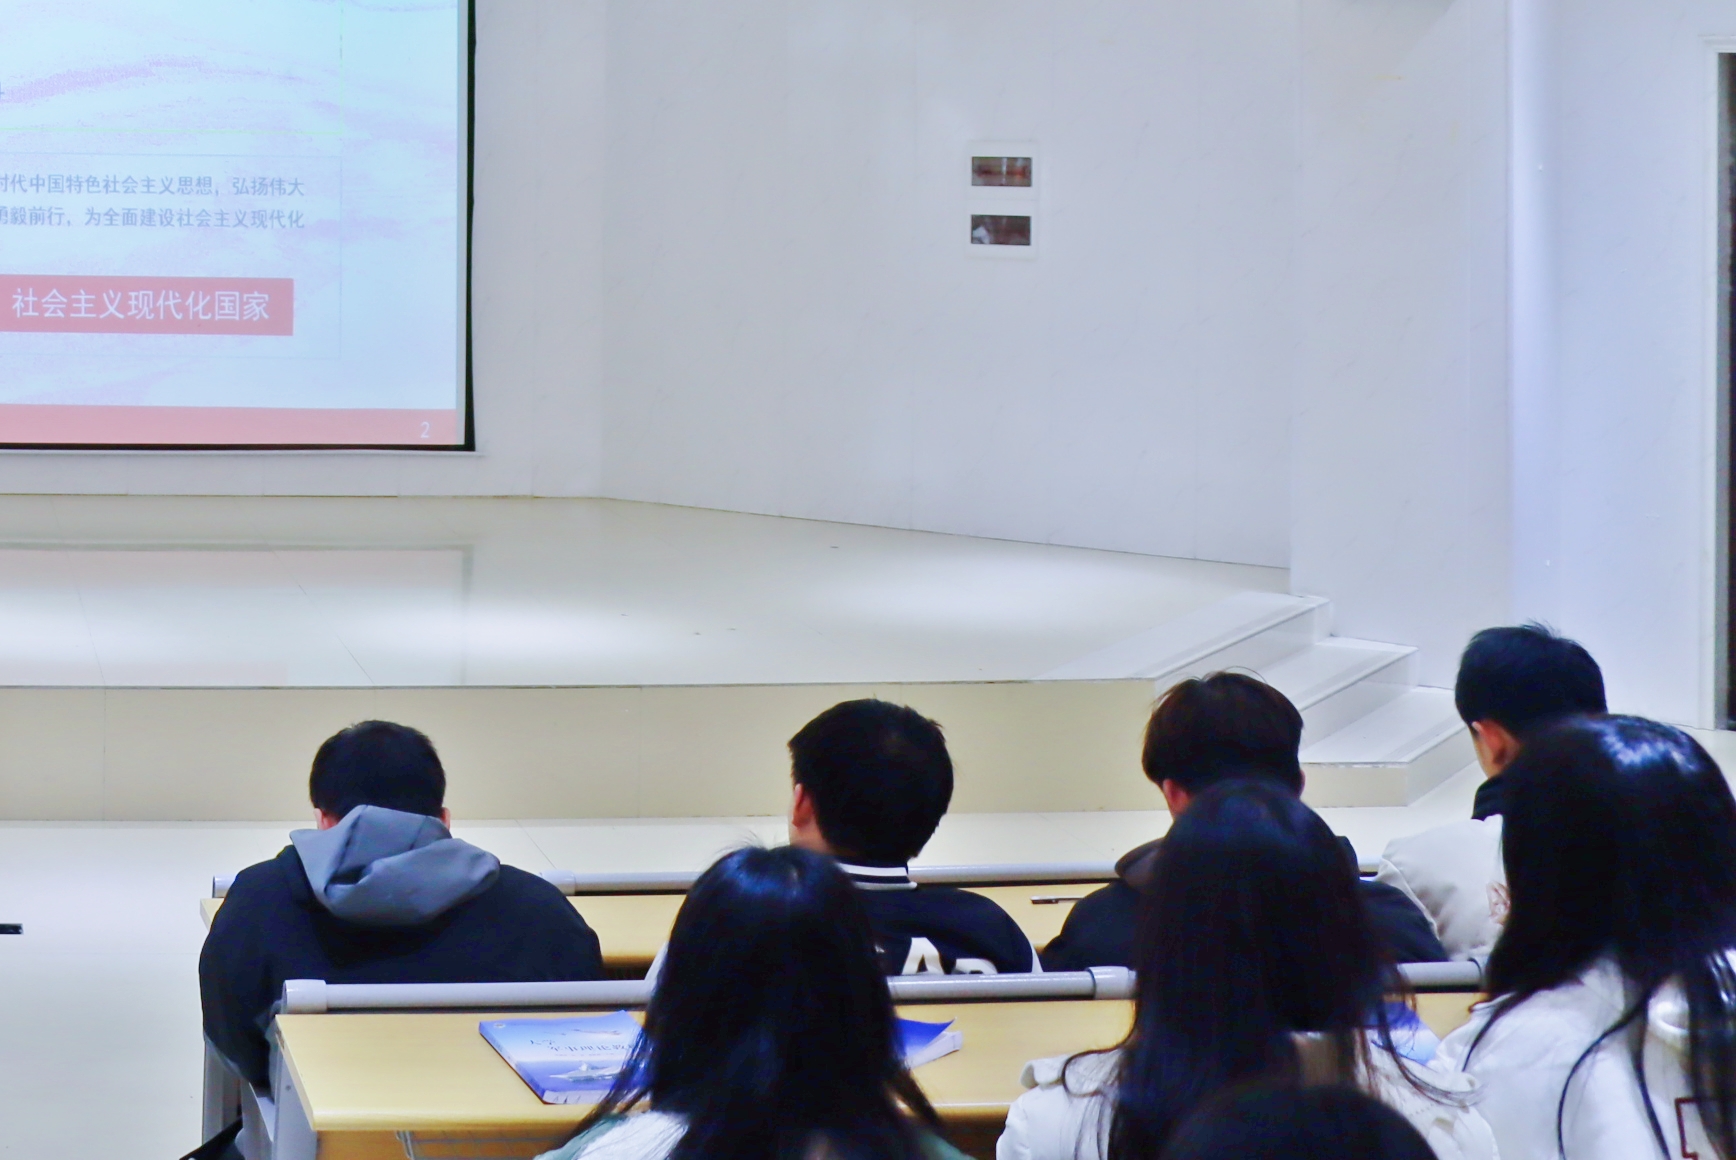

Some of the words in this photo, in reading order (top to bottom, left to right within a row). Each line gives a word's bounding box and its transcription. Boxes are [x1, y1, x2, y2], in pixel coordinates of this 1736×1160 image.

[11, 287, 271, 322] 社会主义现代化国家
[420, 421, 431, 439] 2
